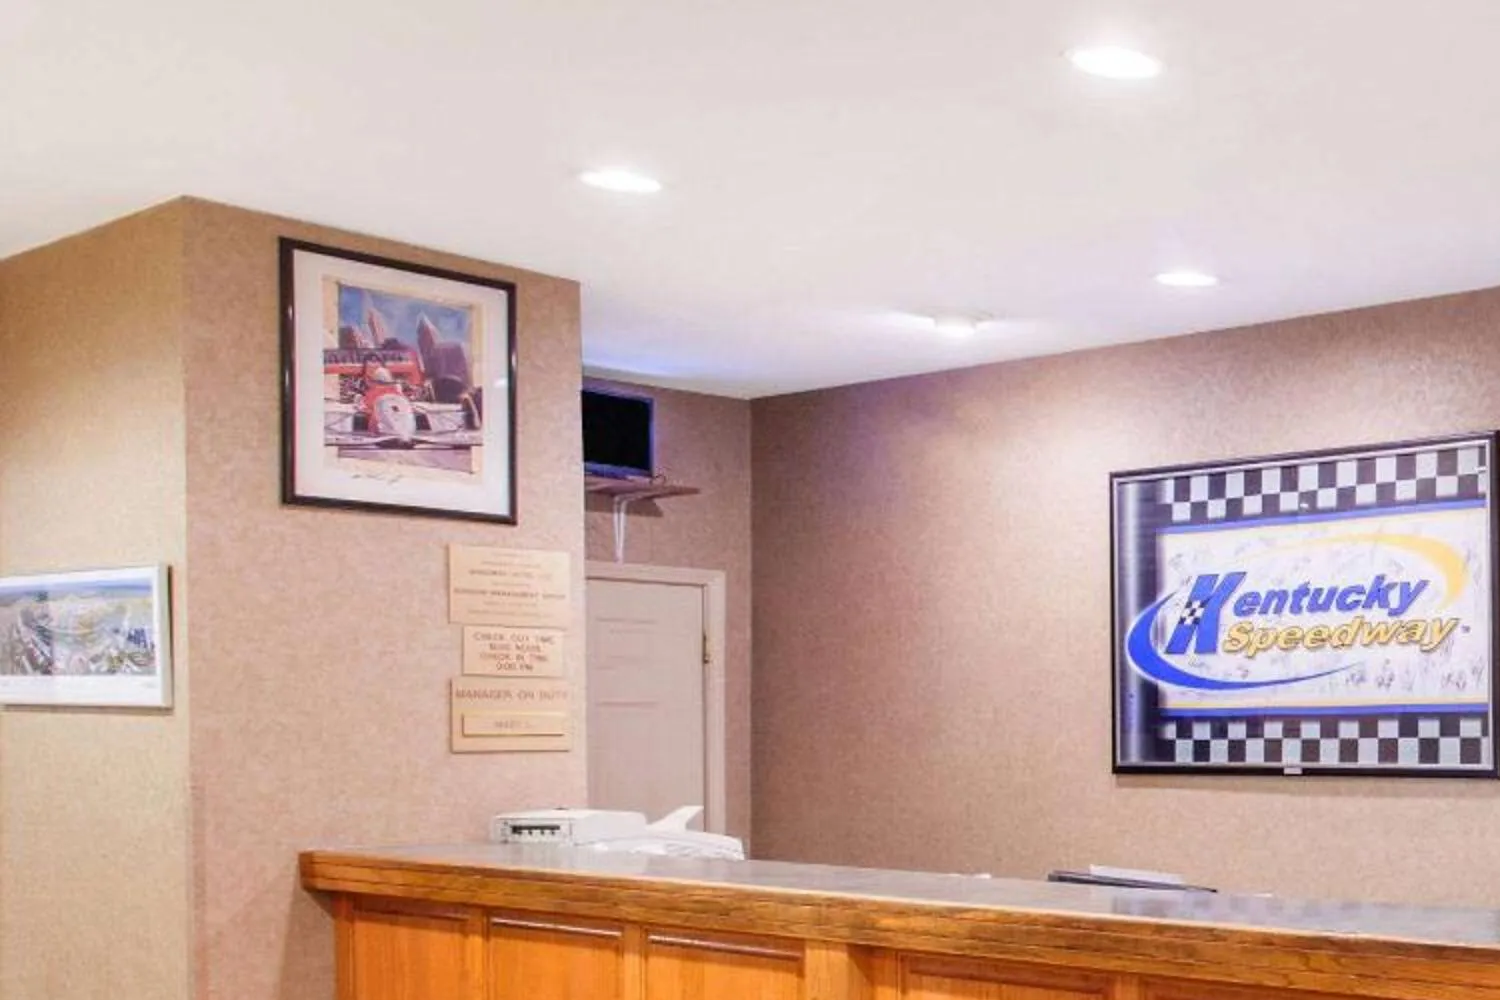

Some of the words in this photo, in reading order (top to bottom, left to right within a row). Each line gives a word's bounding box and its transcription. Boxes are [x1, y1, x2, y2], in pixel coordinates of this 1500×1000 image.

[1164, 570, 1430, 656] Kentucky
[1222, 615, 1459, 660] Speedway
[455, 687, 513, 699] MANAGER
